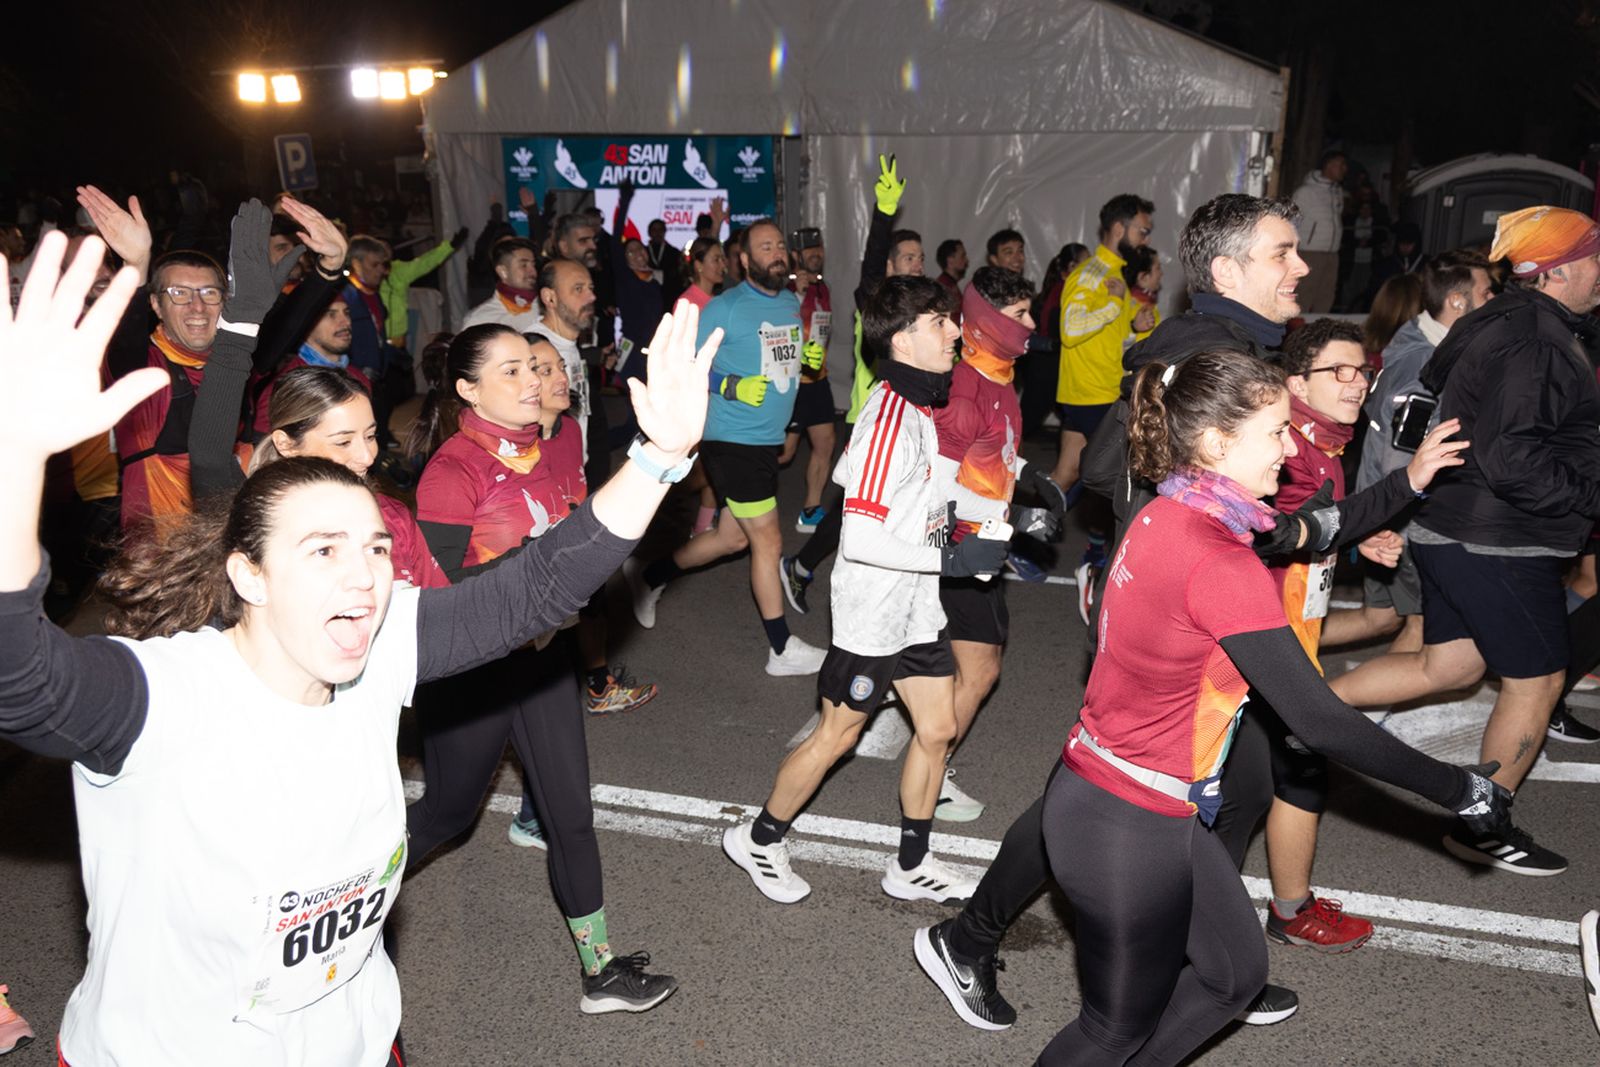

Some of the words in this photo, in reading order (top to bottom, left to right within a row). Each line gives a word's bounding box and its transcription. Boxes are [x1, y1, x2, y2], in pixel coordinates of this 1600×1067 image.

[284, 141, 306, 184] P
[604, 144, 628, 166] 43
[628, 144, 668, 164] SAN
[663, 210, 692, 225] SAN
[772, 344, 797, 361] 1032
[280, 893, 299, 909] 43
[301, 880, 354, 909] NOCHE
[354, 870, 375, 887] DE
[275, 909, 313, 933] SAN
[282, 887, 387, 968] 6032
